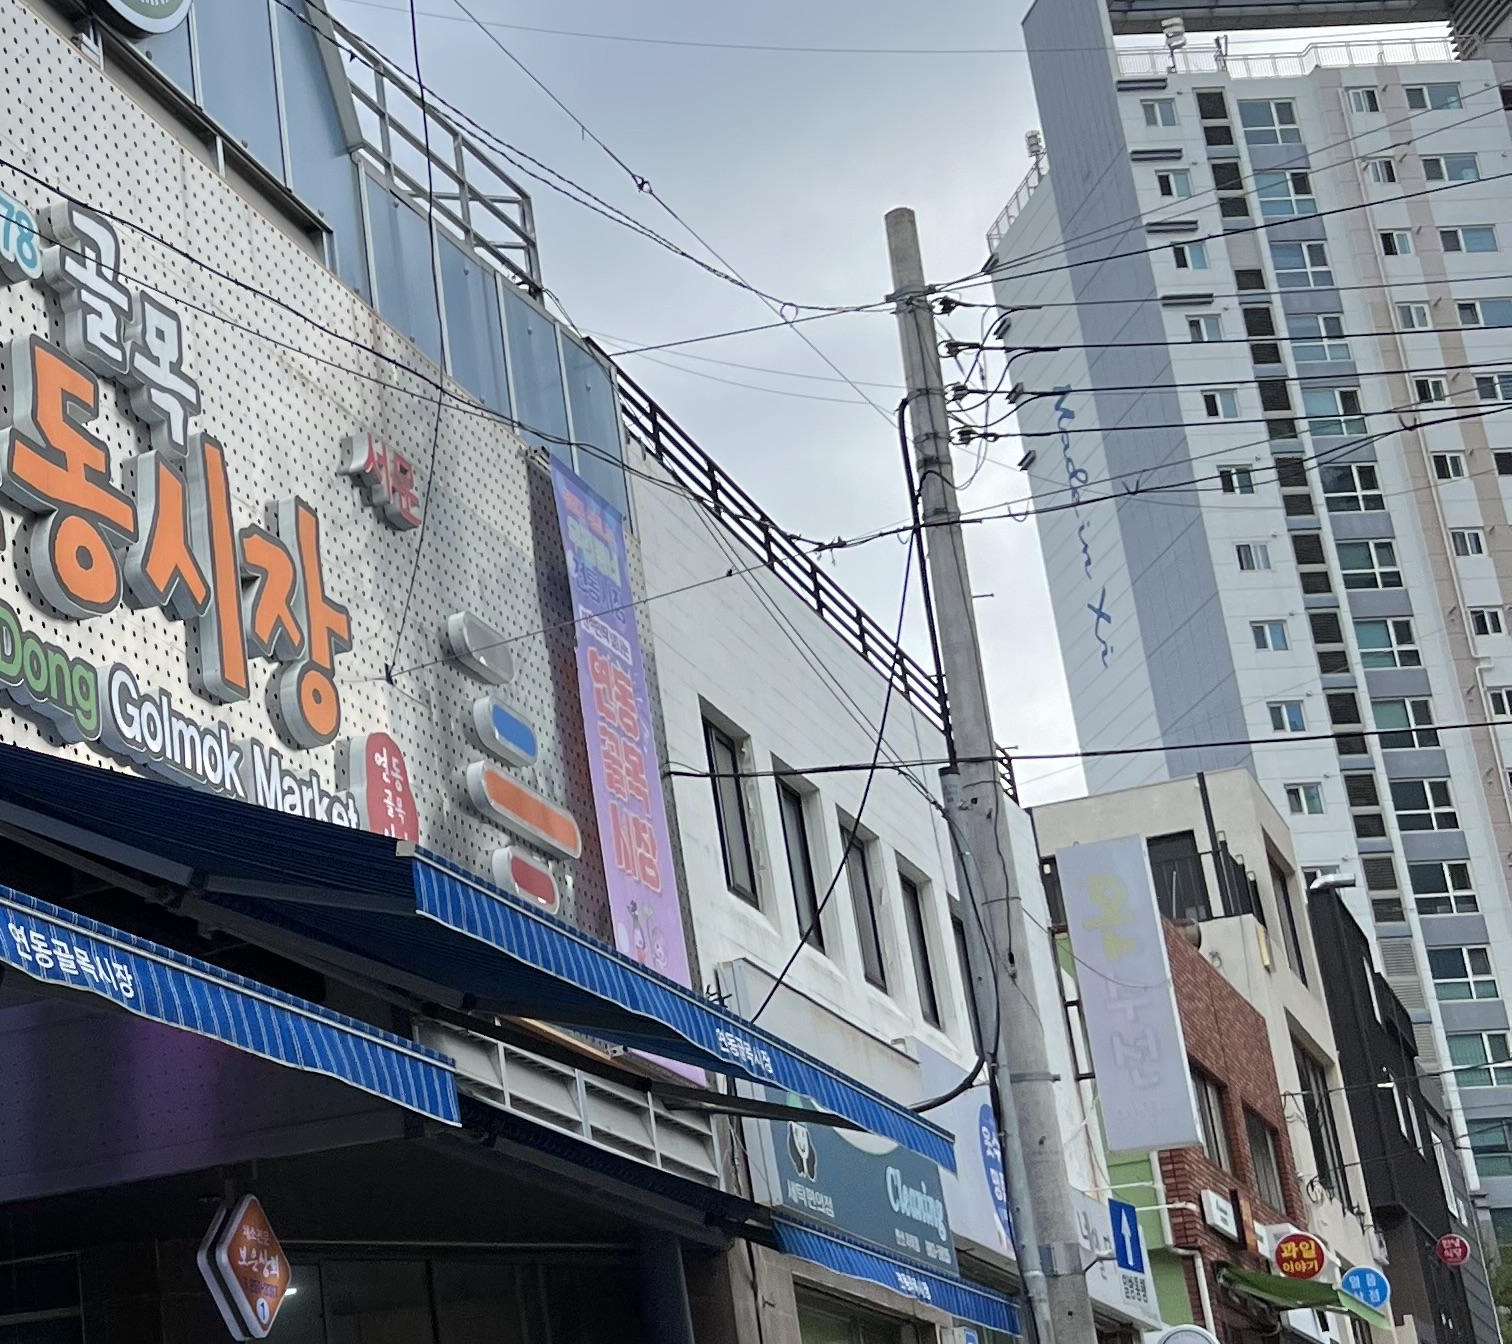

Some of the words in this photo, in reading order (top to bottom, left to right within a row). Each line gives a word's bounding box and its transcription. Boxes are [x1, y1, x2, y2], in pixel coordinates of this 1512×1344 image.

[60, 206, 200, 449] 골목
[110, 671, 245, 797] Golmok
[7, 922, 135, 999] 연동골목시장
[1282, 1259, 1319, 1274] 이야기
